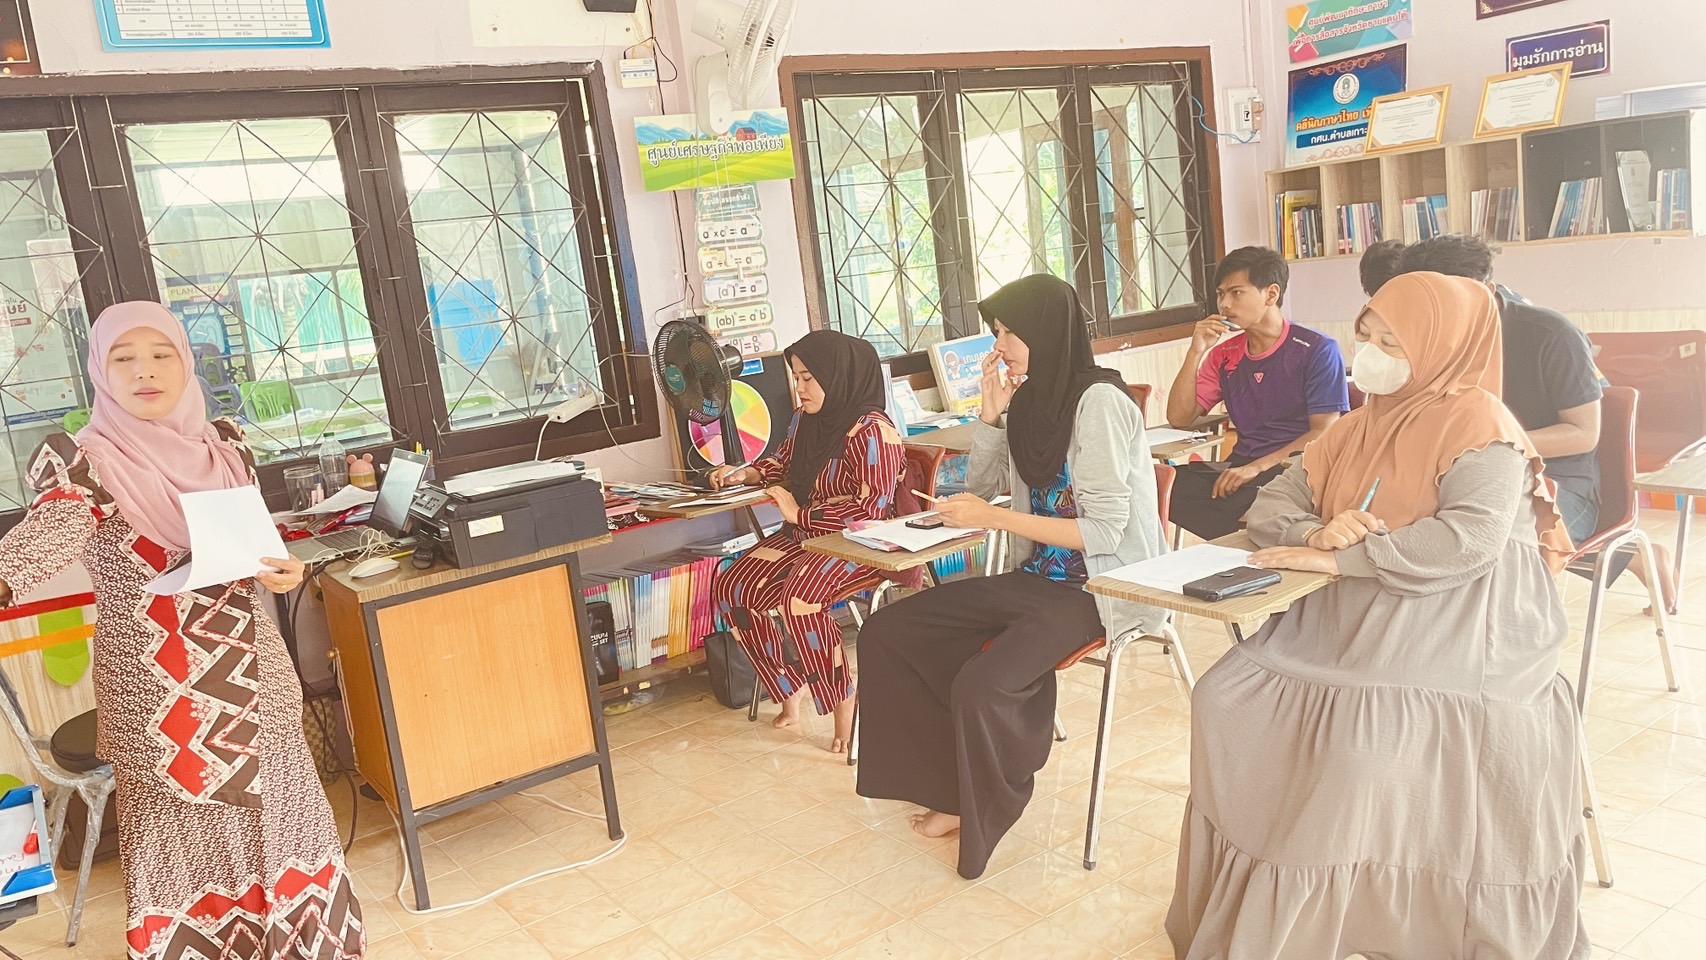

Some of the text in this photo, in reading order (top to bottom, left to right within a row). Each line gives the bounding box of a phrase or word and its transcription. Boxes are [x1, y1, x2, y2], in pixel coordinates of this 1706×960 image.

[1512, 40, 1604, 70] มุมรักการอ่าน
[1310, 126, 1368, 144] กศน.ตำบลเกาะ
[647, 134, 784, 166] ศูนย์เศรษฐกิจพอเพียง
[7, 300, 27, 315] ษย์
